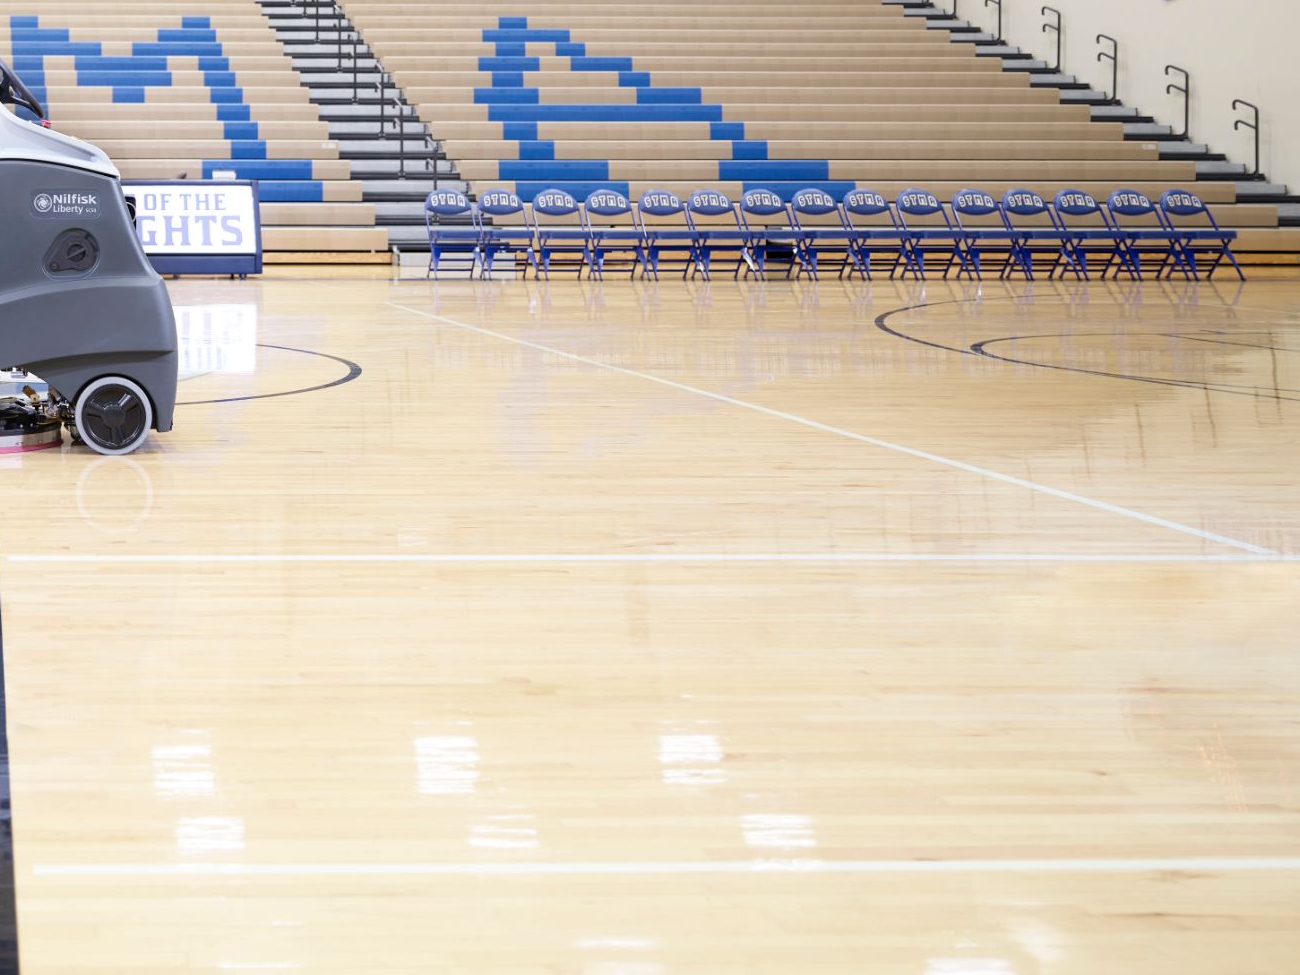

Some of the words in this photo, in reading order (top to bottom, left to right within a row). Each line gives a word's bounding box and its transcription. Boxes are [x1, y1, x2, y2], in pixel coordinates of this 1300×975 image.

[53, 194, 97, 204] Nilfisk
[144, 193, 172, 210] OF
[179, 193, 227, 210] THE
[431, 193, 466, 207] STMA
[484, 193, 518, 207] STMA
[539, 195, 573, 208] STMA
[591, 195, 626, 208] STMA
[645, 195, 679, 207] STMA
[693, 194, 728, 208] STMA
[747, 194, 781, 206] STMA
[798, 193, 833, 206] STMA
[850, 193, 884, 206] STMA
[902, 194, 937, 207] STMA
[958, 194, 993, 208] STMA
[1008, 194, 1043, 207] STMA
[1060, 194, 1095, 208] STMA
[1113, 194, 1149, 207] STMA
[1166, 194, 1201, 207] STMA
[53, 205, 83, 214] Liberty
[136, 215, 243, 246] GHTS
